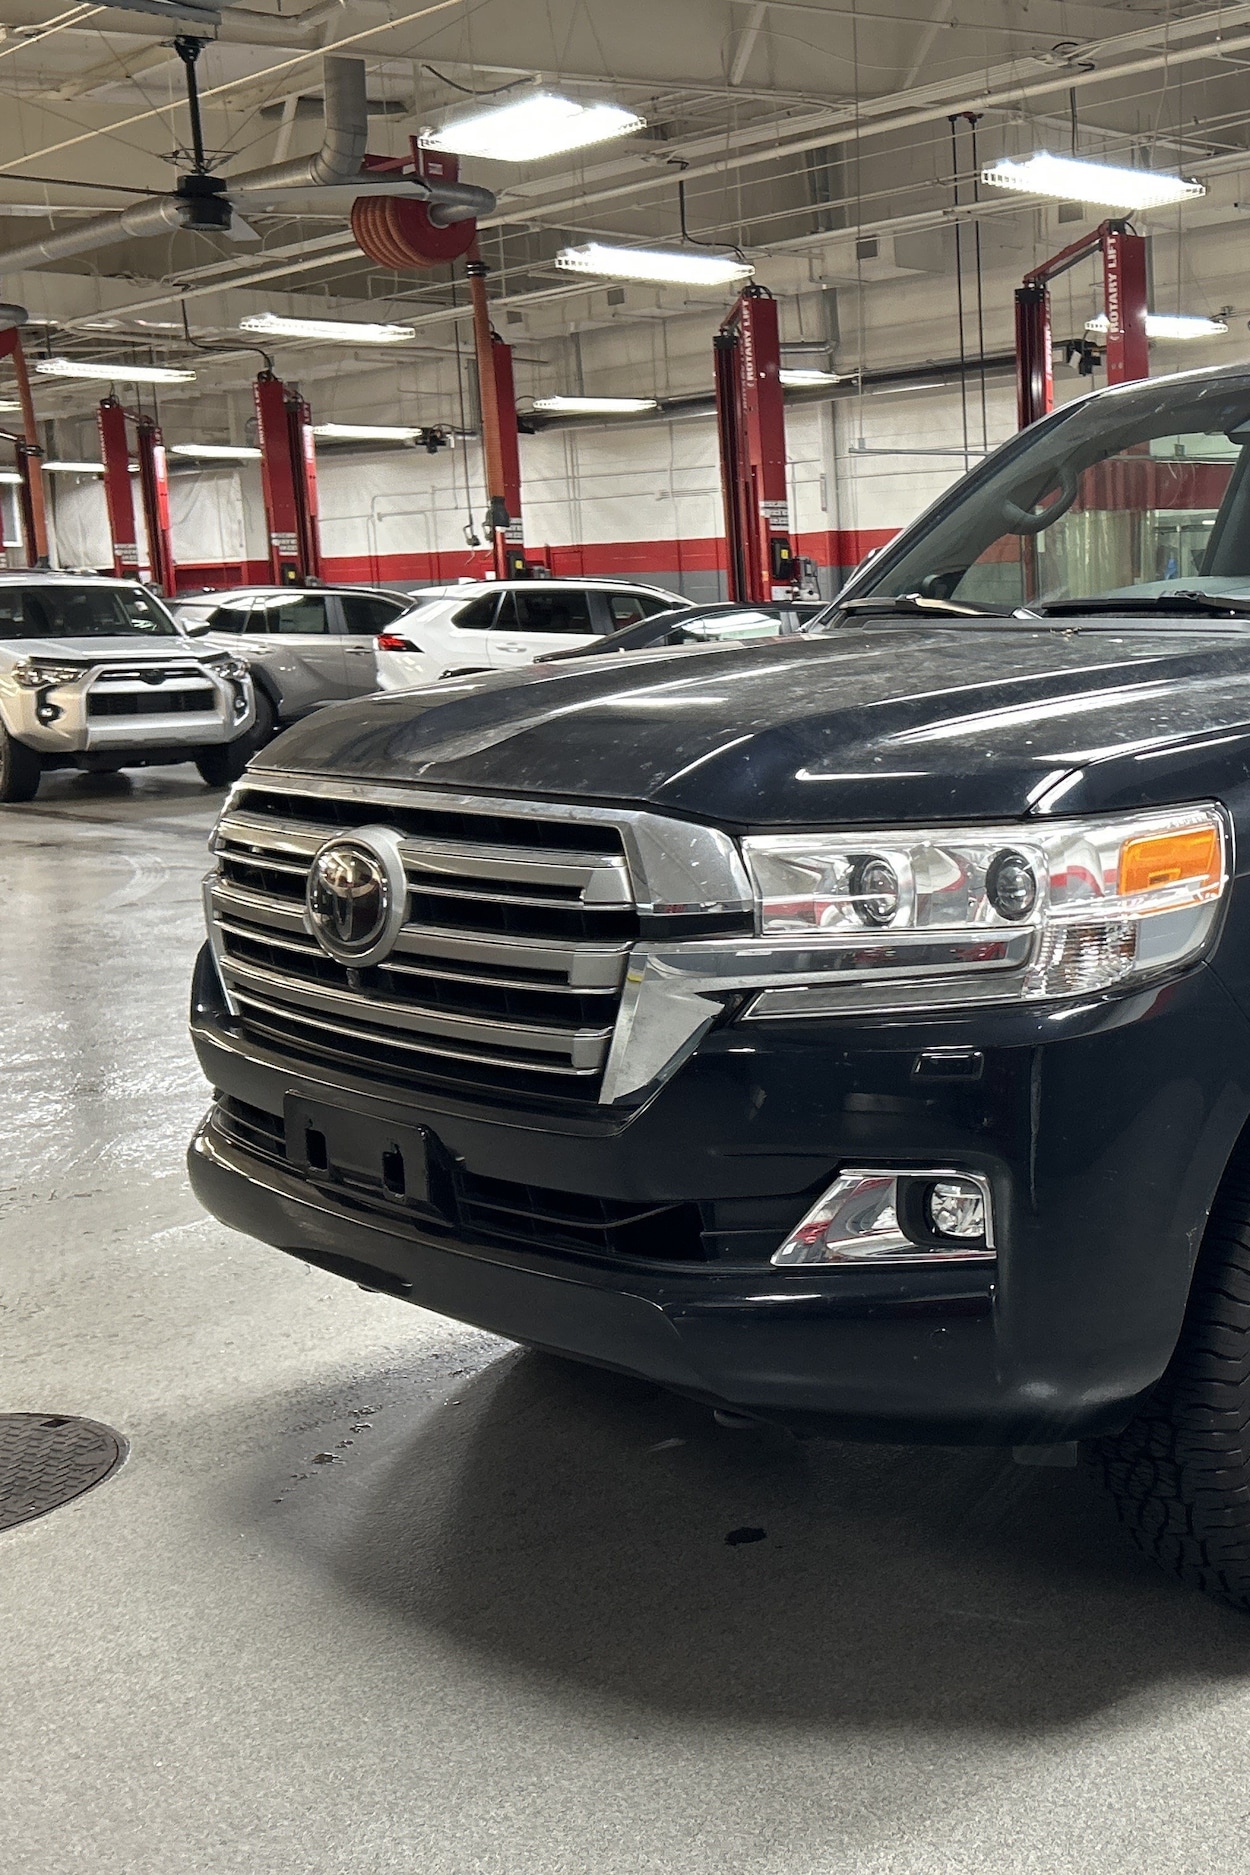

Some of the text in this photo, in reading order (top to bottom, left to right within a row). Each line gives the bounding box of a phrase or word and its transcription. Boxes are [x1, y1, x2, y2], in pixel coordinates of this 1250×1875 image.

[1107, 236, 1119, 333] ROTARY LIFT
[742, 300, 753, 380] ROTARY LIFT
